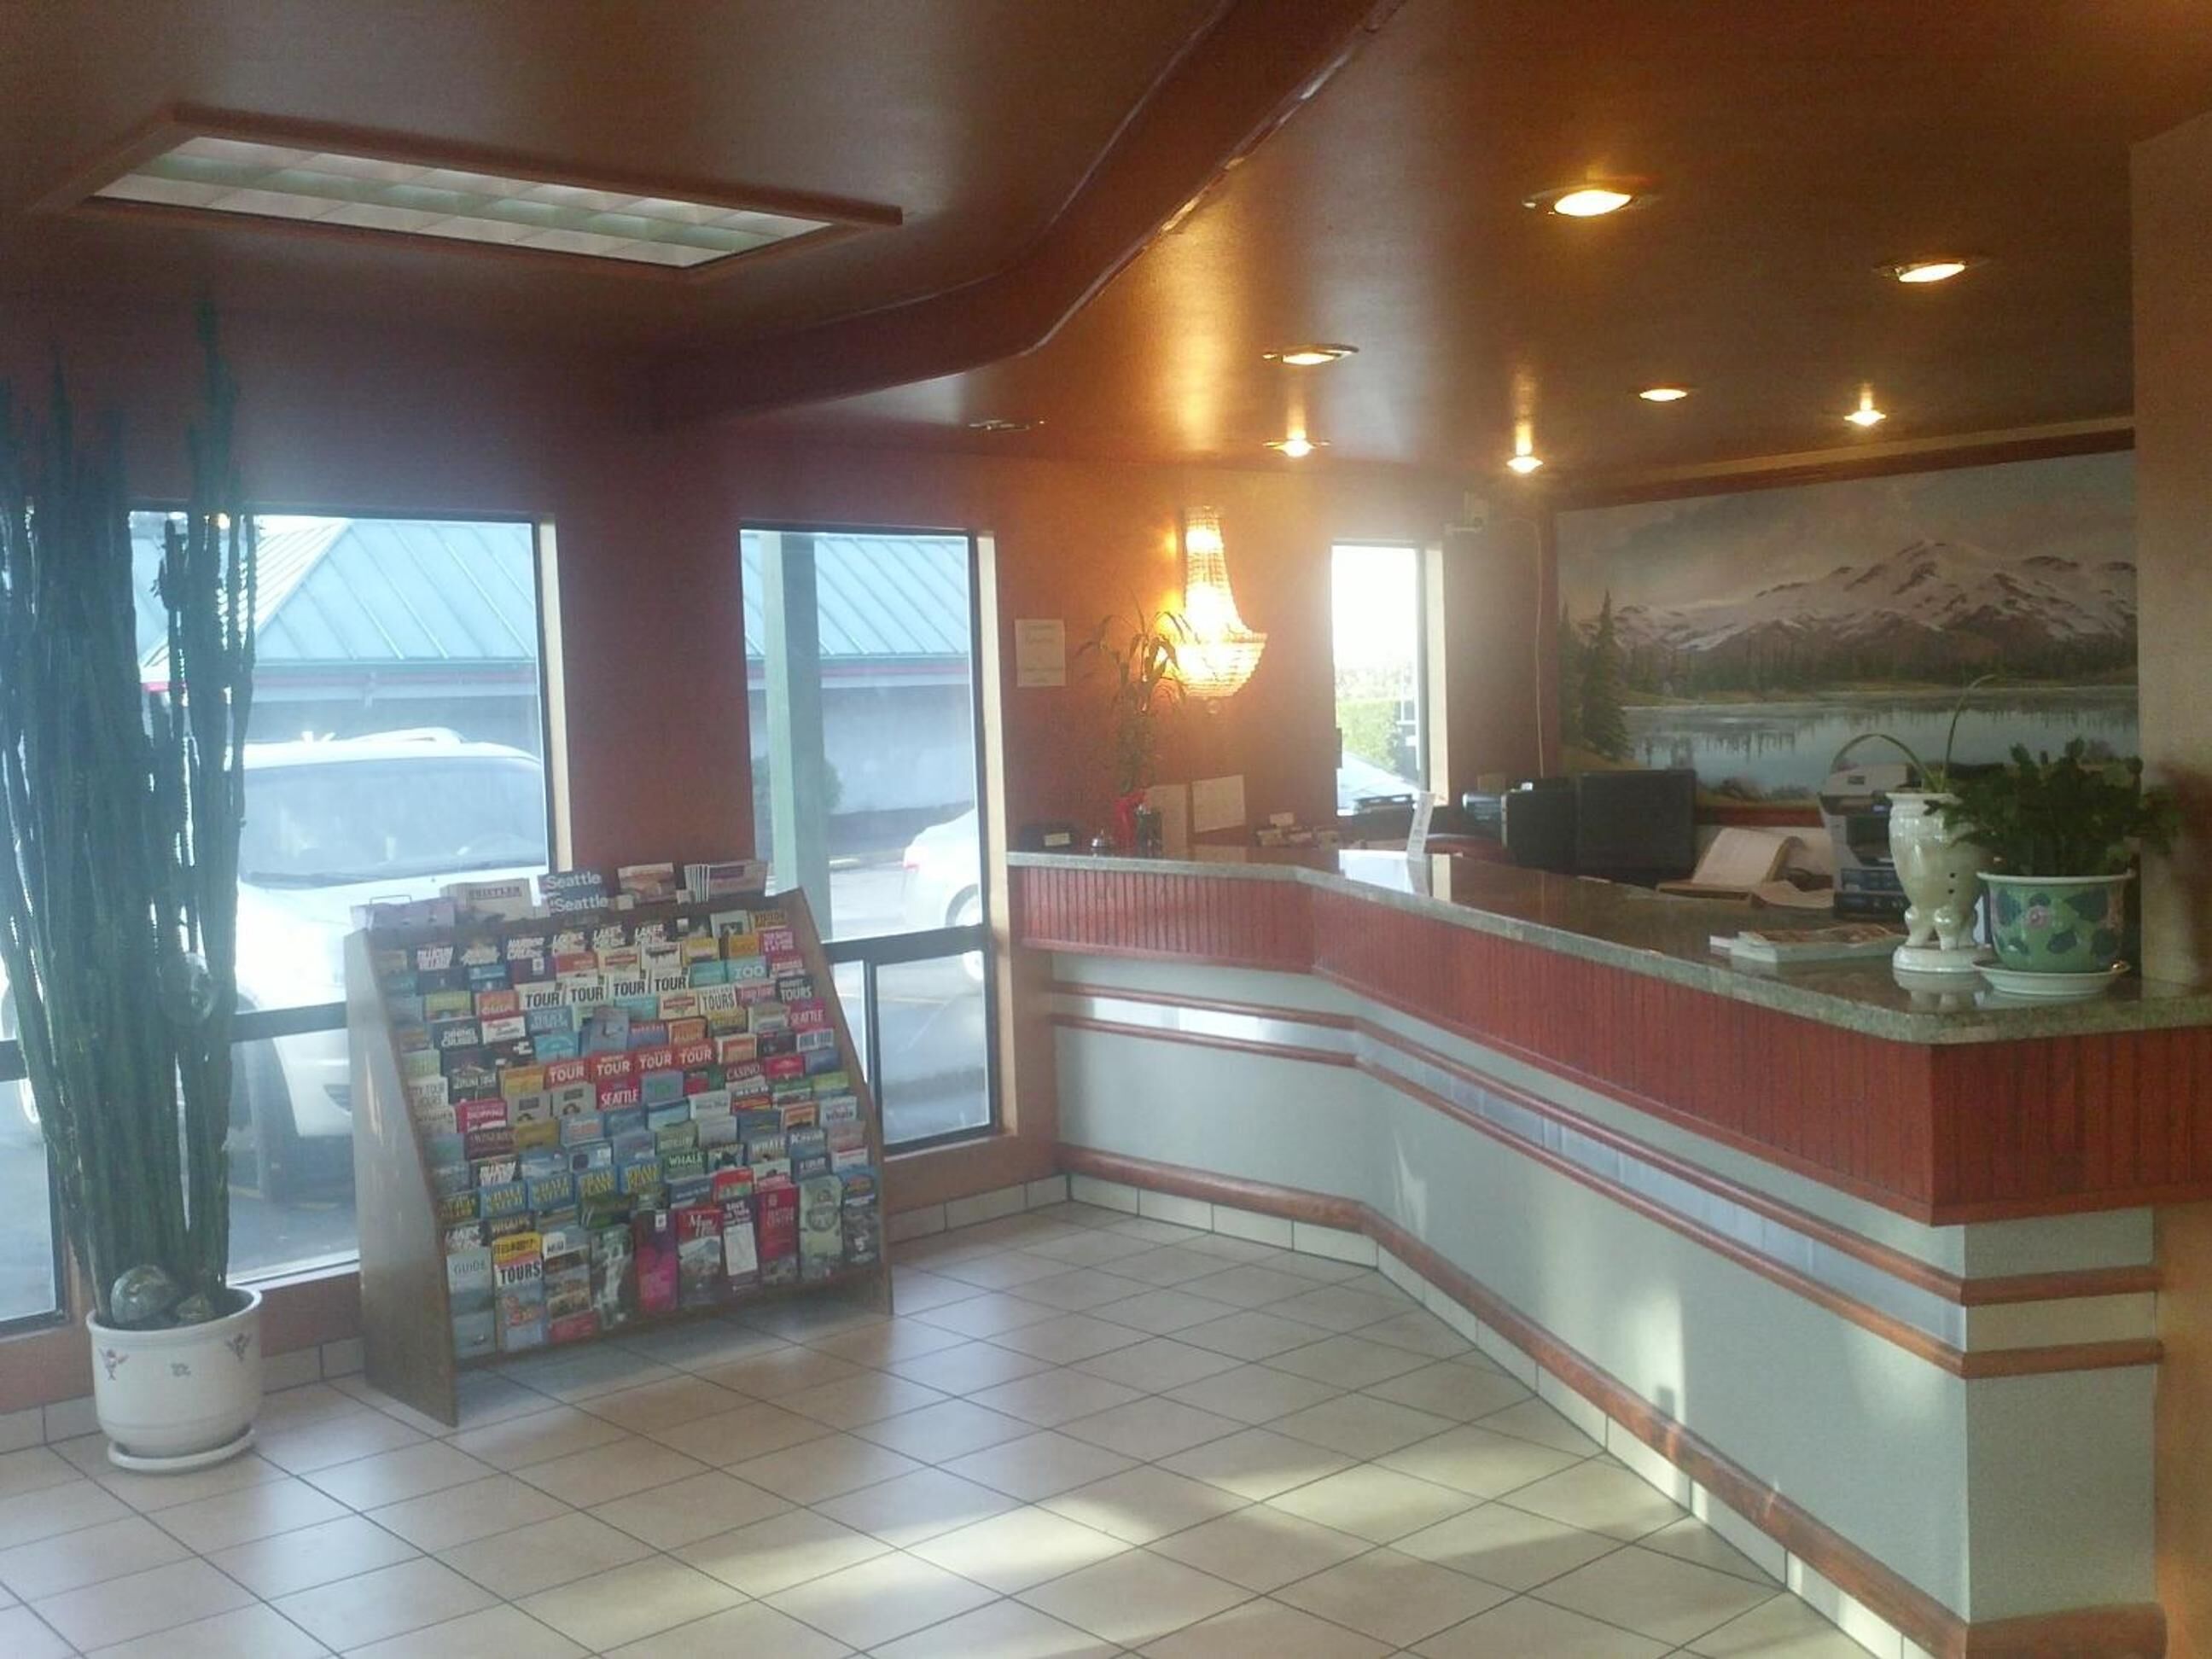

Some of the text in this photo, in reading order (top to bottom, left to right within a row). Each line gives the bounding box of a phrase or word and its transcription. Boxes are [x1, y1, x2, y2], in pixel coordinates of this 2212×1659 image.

[545, 870, 602, 889] Seattle
[555, 895, 609, 912] Seattle
[735, 965, 765, 980] ZOO
[614, 981, 645, 997] TOUR
[655, 976, 686, 992] TOUR
[526, 992, 560, 1008] TOUR
[571, 987, 604, 1003] TOUR
[704, 991, 736, 1010] TOURS
[781, 987, 812, 1001] TOURS
[791, 1010, 825, 1024] SEATTLE
[640, 1054, 672, 1069] TOUR
[681, 1049, 713, 1064] TOUR
[550, 1068, 585, 1083] TOUR
[597, 1061, 631, 1076] TOUR
[726, 1064, 762, 1080] CASINO
[601, 1089, 637, 1106] SEATTLE
[454, 1261, 485, 1275] GUIDE
[500, 1261, 541, 1284] TOURS
